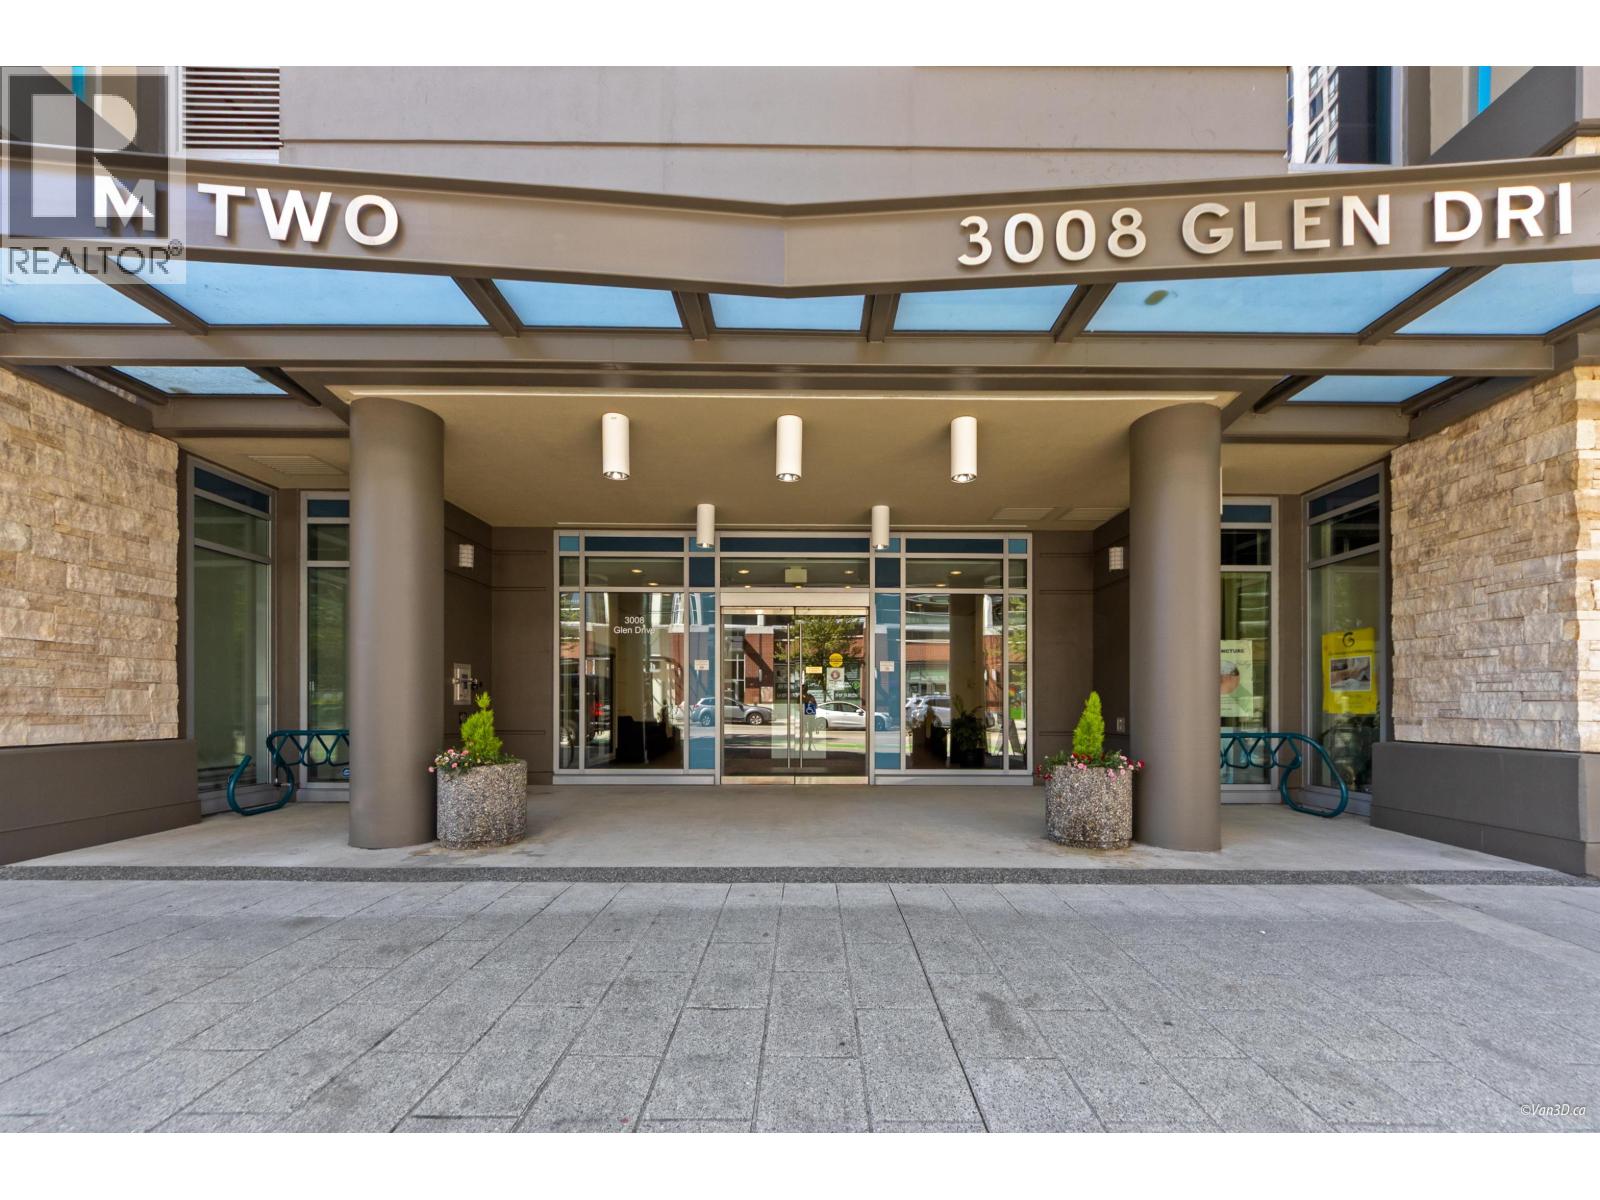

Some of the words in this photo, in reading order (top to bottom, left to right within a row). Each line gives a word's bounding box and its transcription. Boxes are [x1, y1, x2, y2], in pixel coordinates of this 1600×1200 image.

[198, 182, 399, 246] TWO
[957, 207, 1147, 266] 3008
[1181, 194, 1391, 255] GLEN
[1433, 182, 1573, 243] DRI
[613, 626, 633, 634] Glen
[624, 616, 645, 624] 3008
